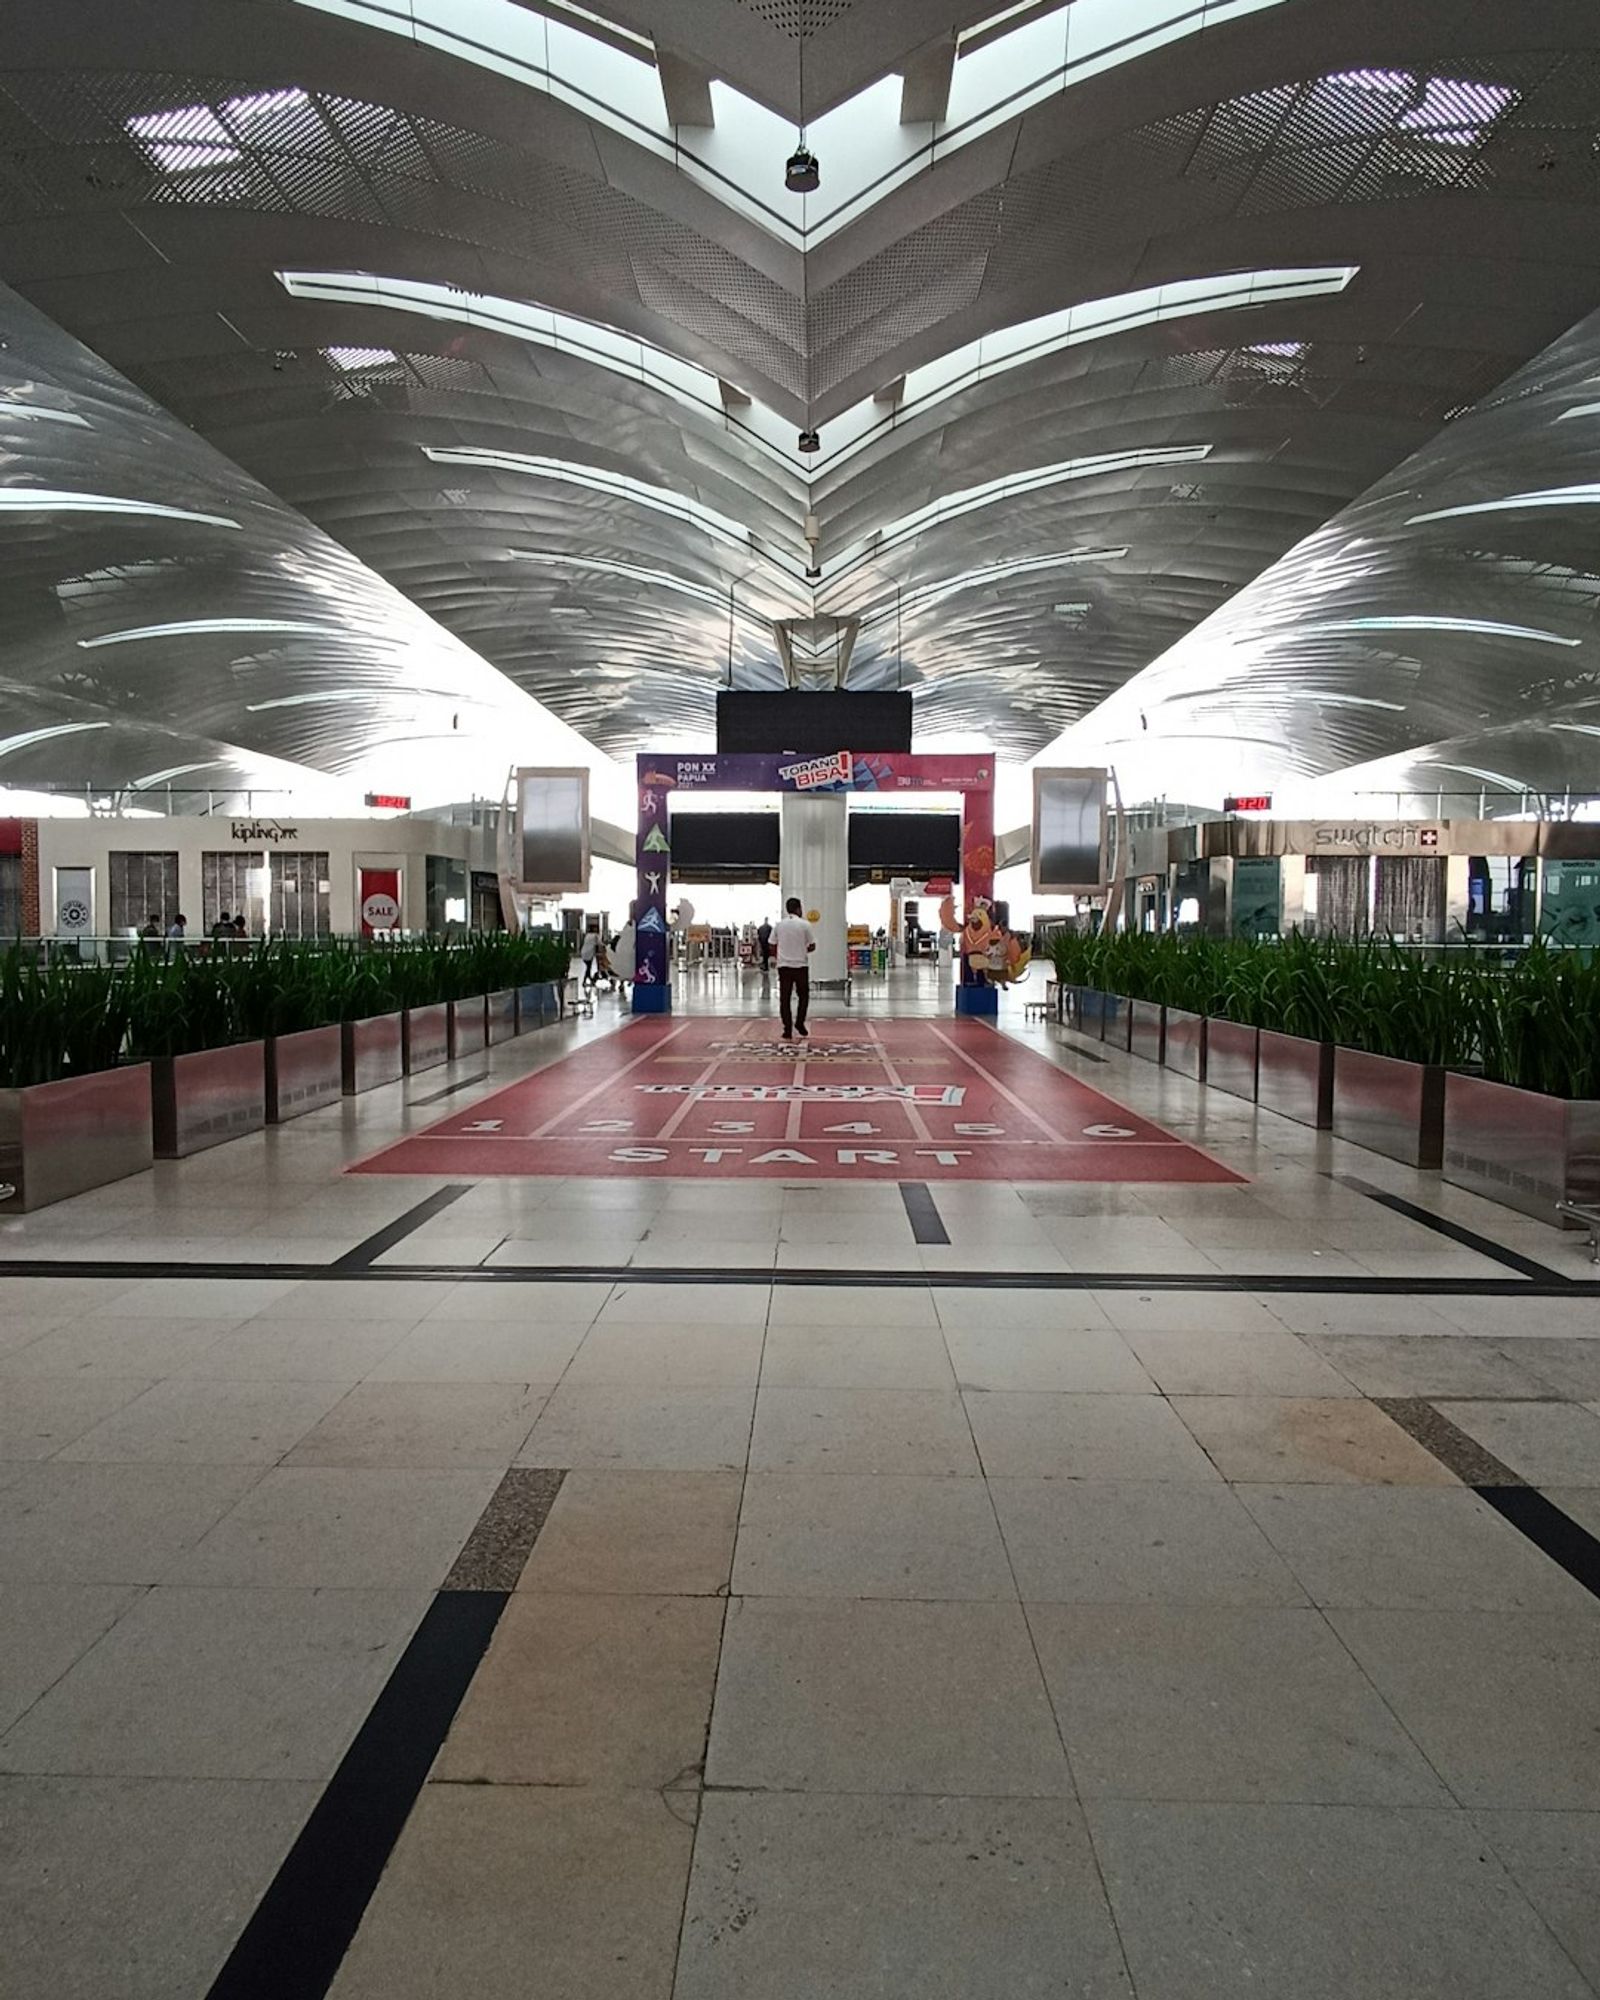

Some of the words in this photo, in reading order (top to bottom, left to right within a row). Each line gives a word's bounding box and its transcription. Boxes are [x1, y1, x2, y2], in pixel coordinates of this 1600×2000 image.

[677, 762, 699, 772] PON
[702, 762, 716, 772] XX
[781, 756, 839, 778] TORANG
[677, 774, 707, 782] PAPUA
[231, 822, 279, 843] kipling
[1315, 825, 1417, 849] swatch
[368, 906, 393, 916] SALE
[460, 1119, 504, 1131] 1
[578, 1119, 634, 1132] 2
[707, 1121, 756, 1133] 3
[823, 1121, 881, 1134] 4
[953, 1123, 1005, 1135] 5
[1082, 1124, 1137, 1137] 6
[608, 1147, 972, 1166] START
